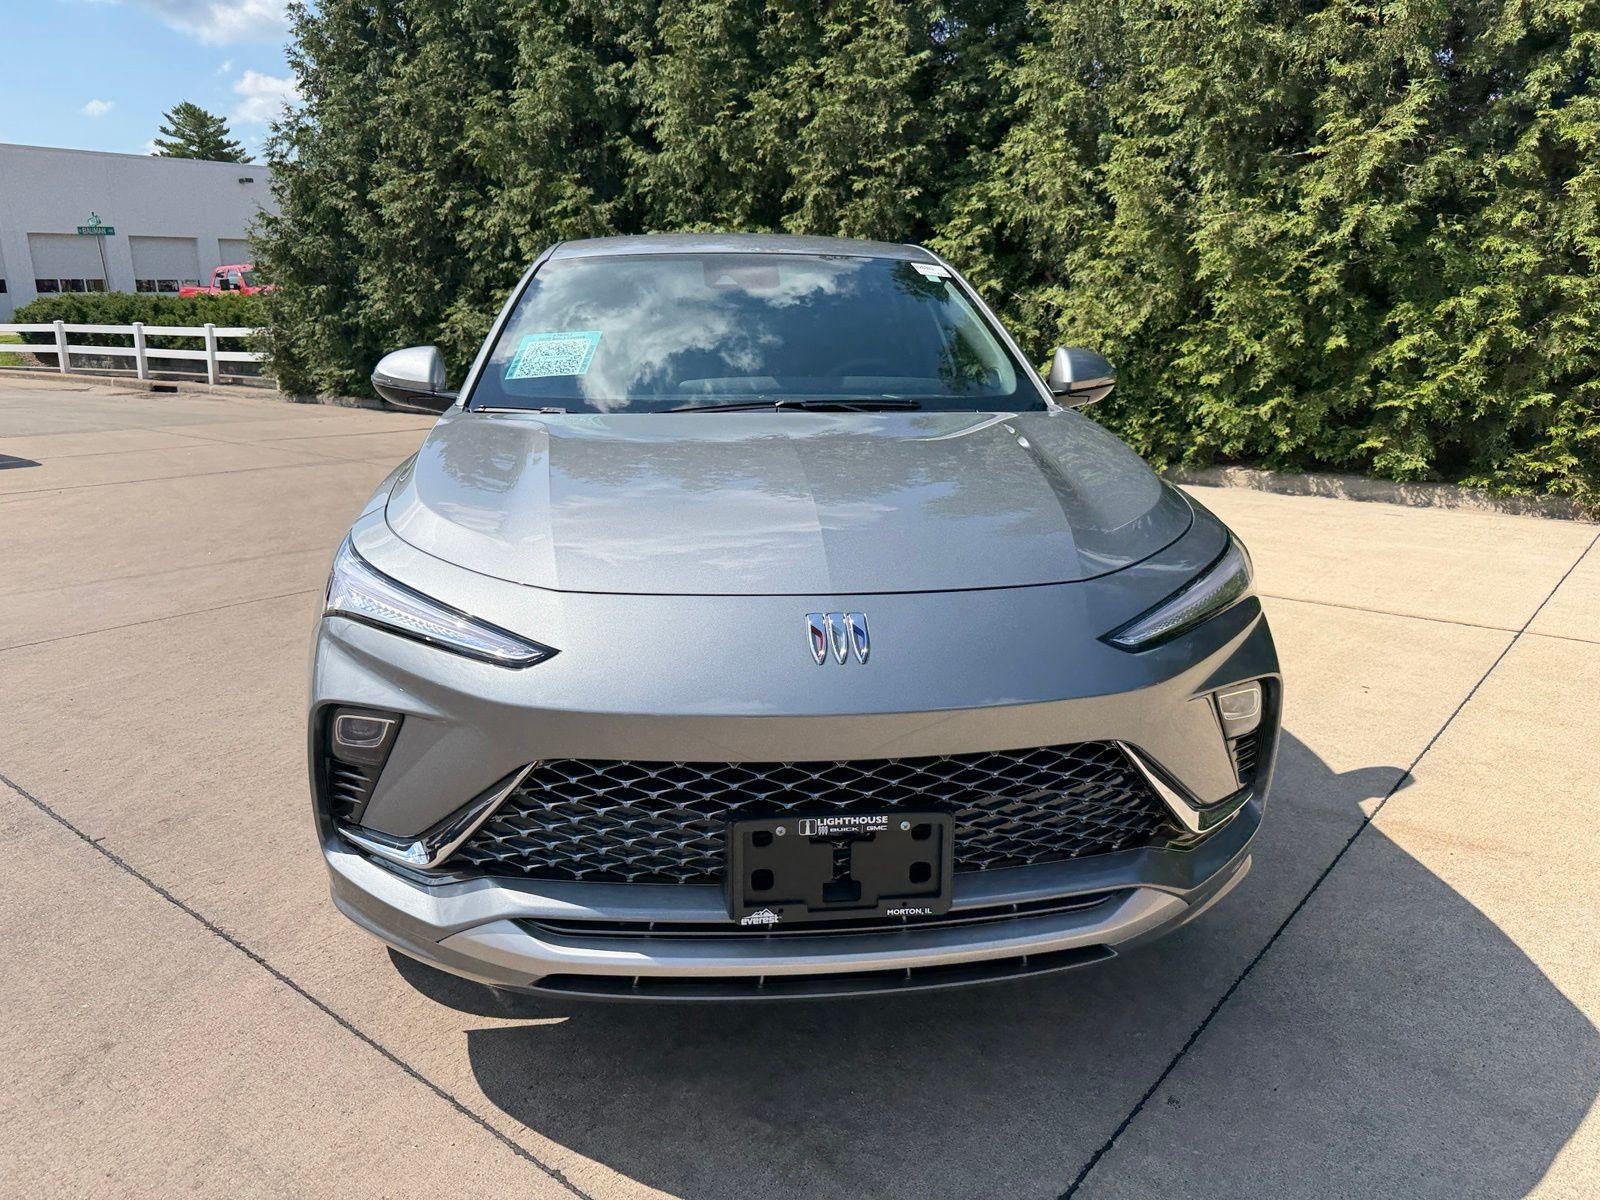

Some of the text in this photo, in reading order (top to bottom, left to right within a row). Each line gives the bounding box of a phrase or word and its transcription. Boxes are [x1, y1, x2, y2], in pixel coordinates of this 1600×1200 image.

[817, 816, 888, 826] LIGHTHOUSE
[886, 908, 923, 916] MORTON,
[740, 914, 779, 926] everest
